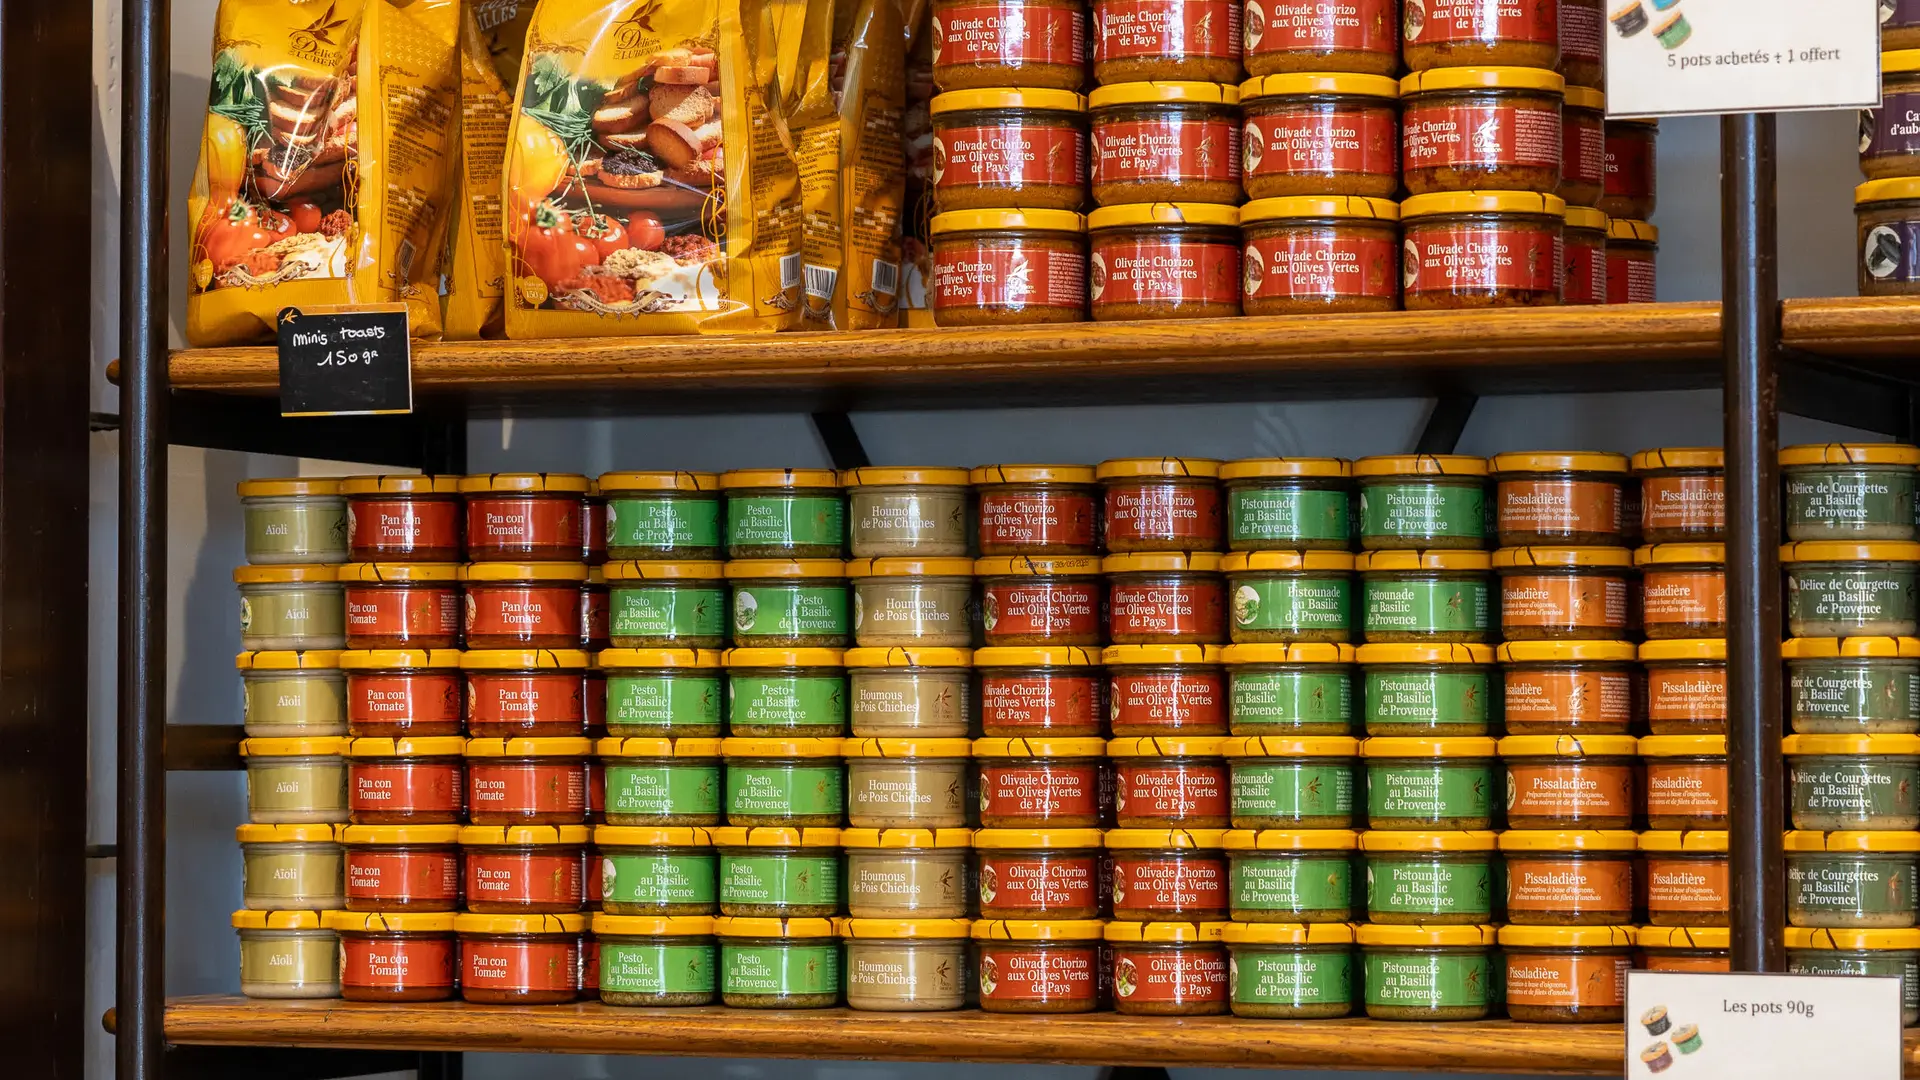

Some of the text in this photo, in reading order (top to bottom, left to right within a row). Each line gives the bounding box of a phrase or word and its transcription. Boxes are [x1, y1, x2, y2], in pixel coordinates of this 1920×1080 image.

[1275, 4, 1355, 16] Olivade Chorizo
[1272, 15, 1359, 28] aux Olives Vertes
[1295, 26, 1335, 39] de Pays
[1668, 54, 1676, 67] 5
[1681, 55, 1711, 69] pots
[1716, 50, 1769, 65] achetés
[1788, 50, 1794, 62] 1
[1800, 48, 1840, 62] offert
[954, 139, 1031, 152] Olivade Chorizo
[952, 150, 1035, 163] aux Olives Vertes
[972, 161, 1009, 174] de Pays
[1427, 243, 1508, 255] Olivade Chorizo
[1425, 254, 1512, 266] aux Olives Vertes
[1446, 266, 1486, 279] de Pays
[340, 326, 385, 339] toasts
[317, 350, 358, 366] 150
[1817, 482, 1828, 494] de
[1832, 482, 1888, 496] Courgettes
[1508, 494, 1565, 505] Pissaladière
[1661, 490, 1723, 502] Pissaladière
[1810, 494, 1861, 506] au Basilic
[1241, 499, 1295, 509] Pistounade
[649, 506, 677, 517] Pesto
[1244, 511, 1291, 522] au Basilic
[1806, 507, 1868, 518] de Provence
[381, 515, 421, 525] Pan con
[639, 518, 687, 529] au Basilic
[266, 524, 288, 535] Aïoli
[381, 526, 420, 536] Tomate
[1240, 522, 1299, 533] de Provence
[633, 530, 693, 540] de Provence
[1800, 579, 1899, 592] Délice de Courgettes
[797, 595, 823, 605] Pesto
[1010, 592, 1088, 603] Olivade Chorizo
[1822, 591, 1874, 602] au Basilic
[502, 602, 541, 612] Pan con
[886, 599, 936, 609] Houmous
[1008, 604, 1090, 615] aux Olives Vertes
[1816, 604, 1881, 614] de Provence
[286, 608, 309, 619] Aïoli
[785, 606, 831, 617] au Basilic
[874, 610, 949, 621] de Pois Chiches
[502, 614, 541, 624] Tomate
[779, 618, 836, 629] de Provence
[1031, 616, 1070, 629] de Pays
[1380, 680, 1435, 692] Pistounade
[1662, 682, 1722, 693] Pissaladière
[368, 690, 405, 700] Pan con
[1383, 693, 1431, 704] au Basilic
[277, 696, 300, 707] Aïoli
[368, 701, 404, 711] Tomate
[1378, 705, 1438, 716] de Provence
[359, 778, 391, 788] Pan con
[869, 780, 917, 791] Houmous
[1000, 775, 1079, 785] Olivade Chorizo
[1533, 778, 1596, 789] Pissaladière
[1652, 778, 1702, 789] Pissaladière
[276, 781, 299, 793] Aïoli
[998, 786, 1081, 797] aux Olives Vertes
[359, 789, 391, 799] Tomate
[858, 792, 931, 803] de Pois Chiches
[1020, 798, 1059, 811] de Pays
[274, 869, 297, 879] Aïoli
[652, 863, 679, 874] Pesto
[641, 875, 689, 885] au Basilic
[1525, 873, 1586, 884] Pissaladière
[634, 886, 694, 897] de Provence
[269, 955, 292, 966] Aïoli
[369, 954, 408, 964] Pan con
[737, 954, 760, 965] Pesto
[369, 966, 408, 975] Tomate
[730, 965, 771, 976] au Basilic
[1257, 960, 1316, 972] Pistounade
[727, 977, 777, 988] de Provence
[1261, 973, 1312, 984] au Basilic
[1255, 985, 1318, 996] de Provence
[1723, 999, 1814, 1017] Les pots 90g
